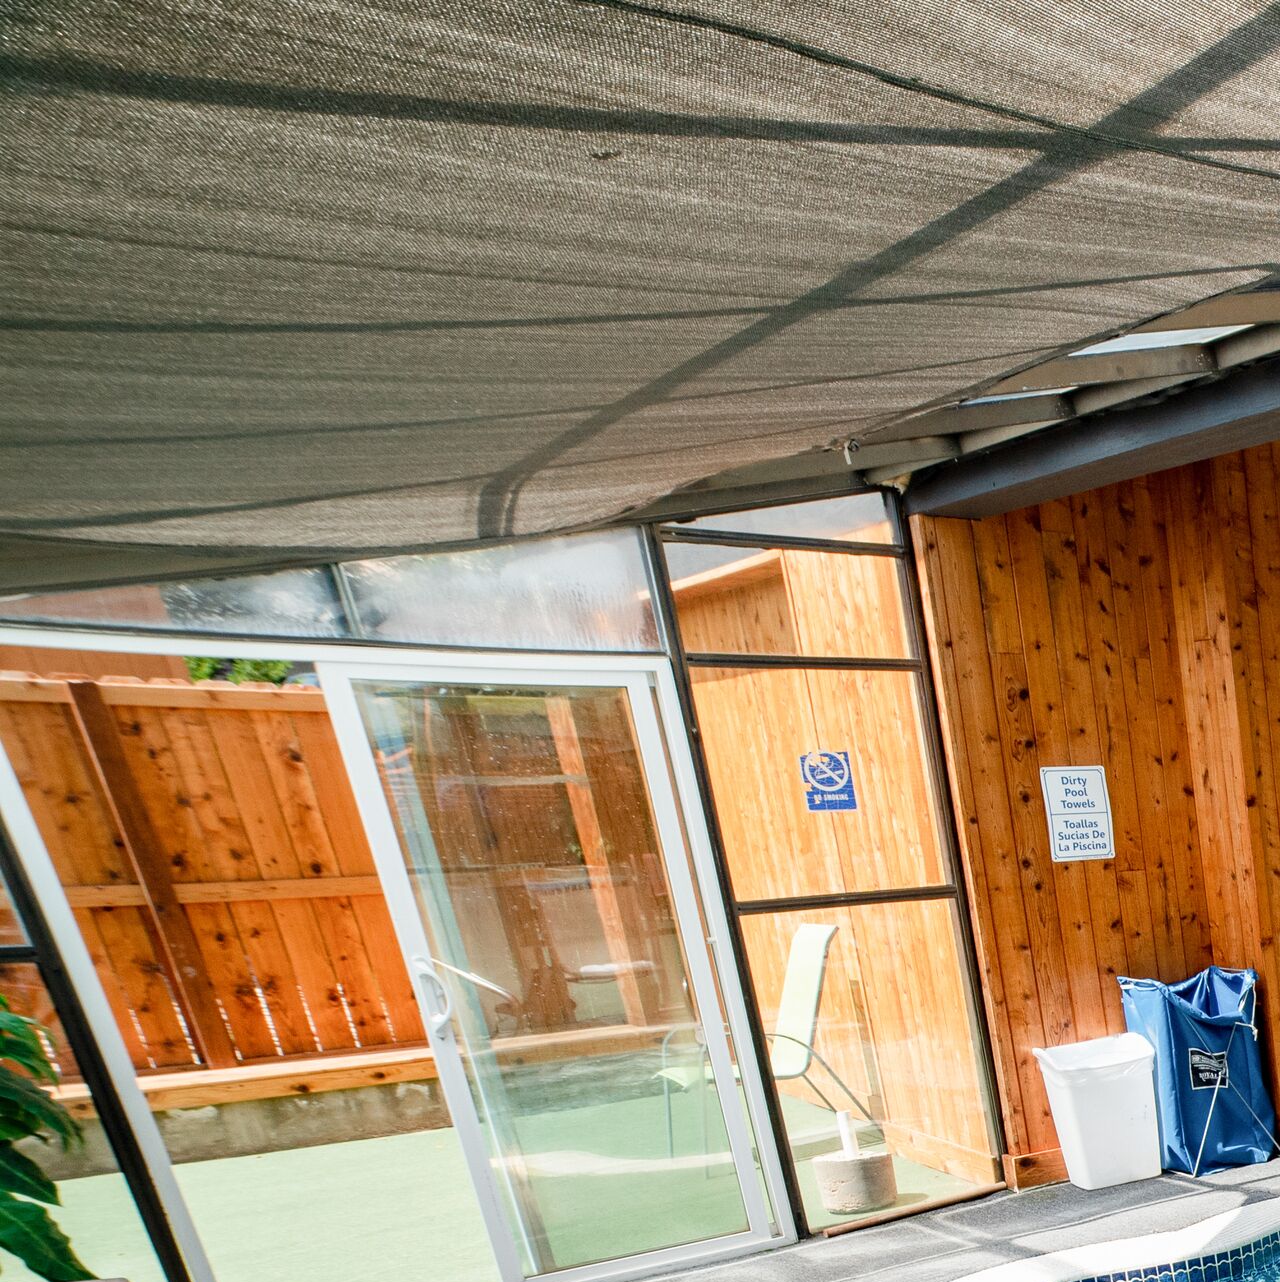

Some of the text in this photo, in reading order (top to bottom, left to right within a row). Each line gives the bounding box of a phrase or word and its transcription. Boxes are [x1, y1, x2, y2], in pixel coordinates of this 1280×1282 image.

[1061, 776, 1087, 787] Dirty
[1064, 788, 1088, 797] Pool
[1060, 799, 1096, 809] Towels
[1063, 820, 1098, 829] Toallas
[1058, 830, 1106, 841] Sucias De
[1058, 841, 1107, 852] La Piscina
